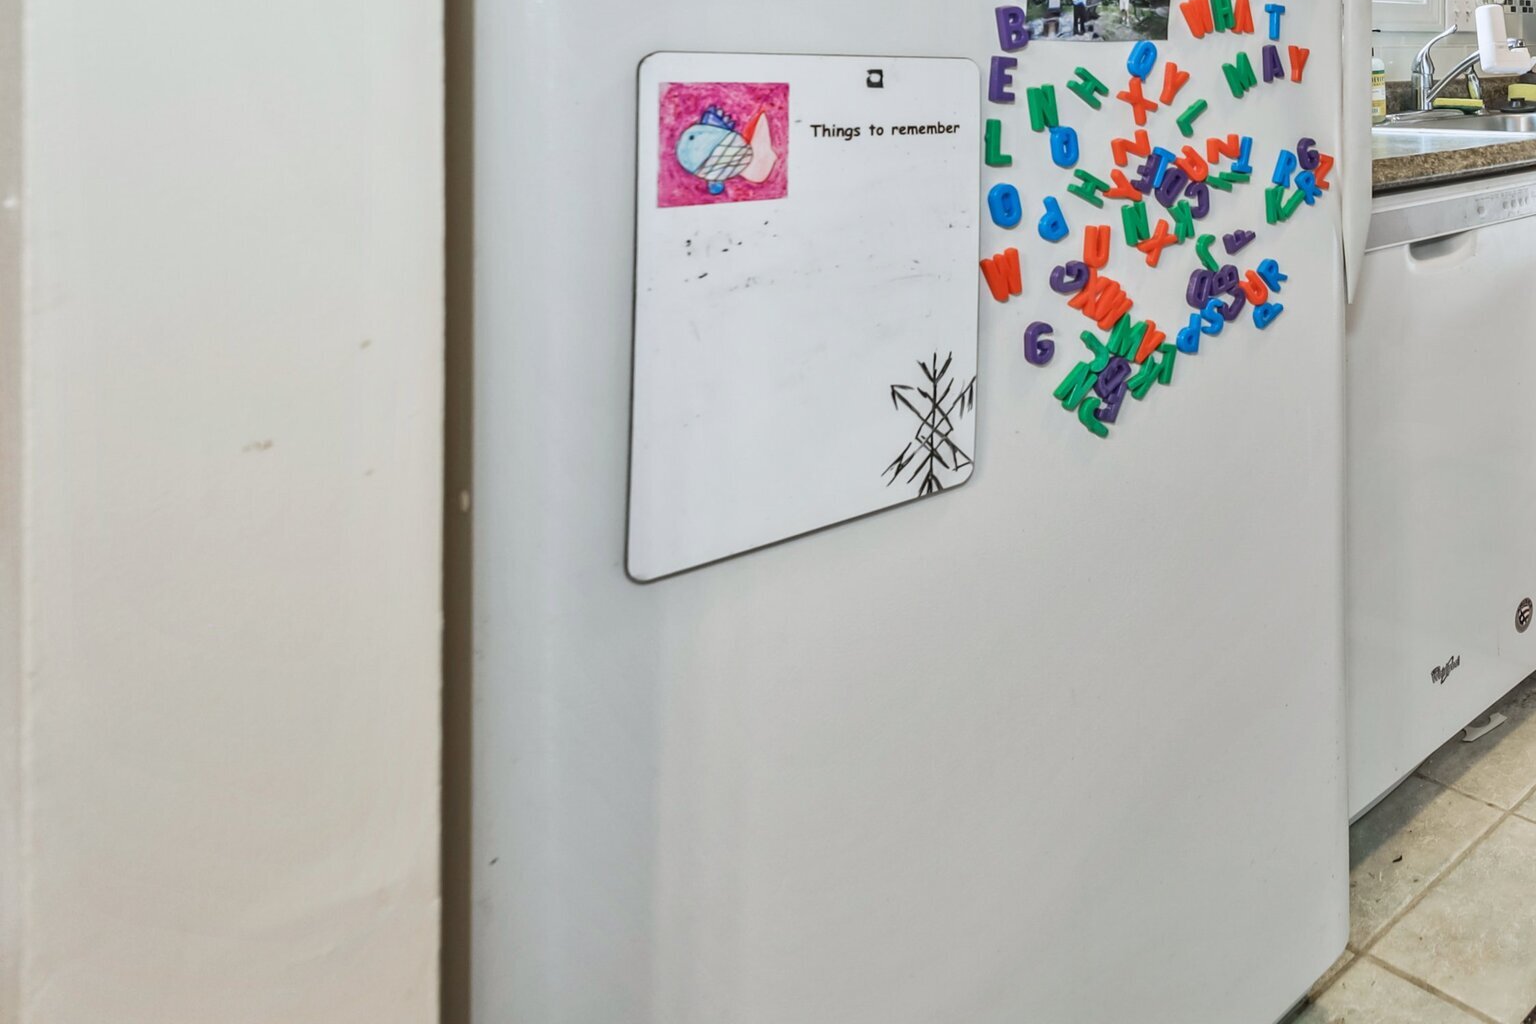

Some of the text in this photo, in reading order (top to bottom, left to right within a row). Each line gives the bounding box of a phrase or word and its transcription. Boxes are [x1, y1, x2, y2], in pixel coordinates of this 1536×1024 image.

[810, 122, 960, 141] Things to remember
